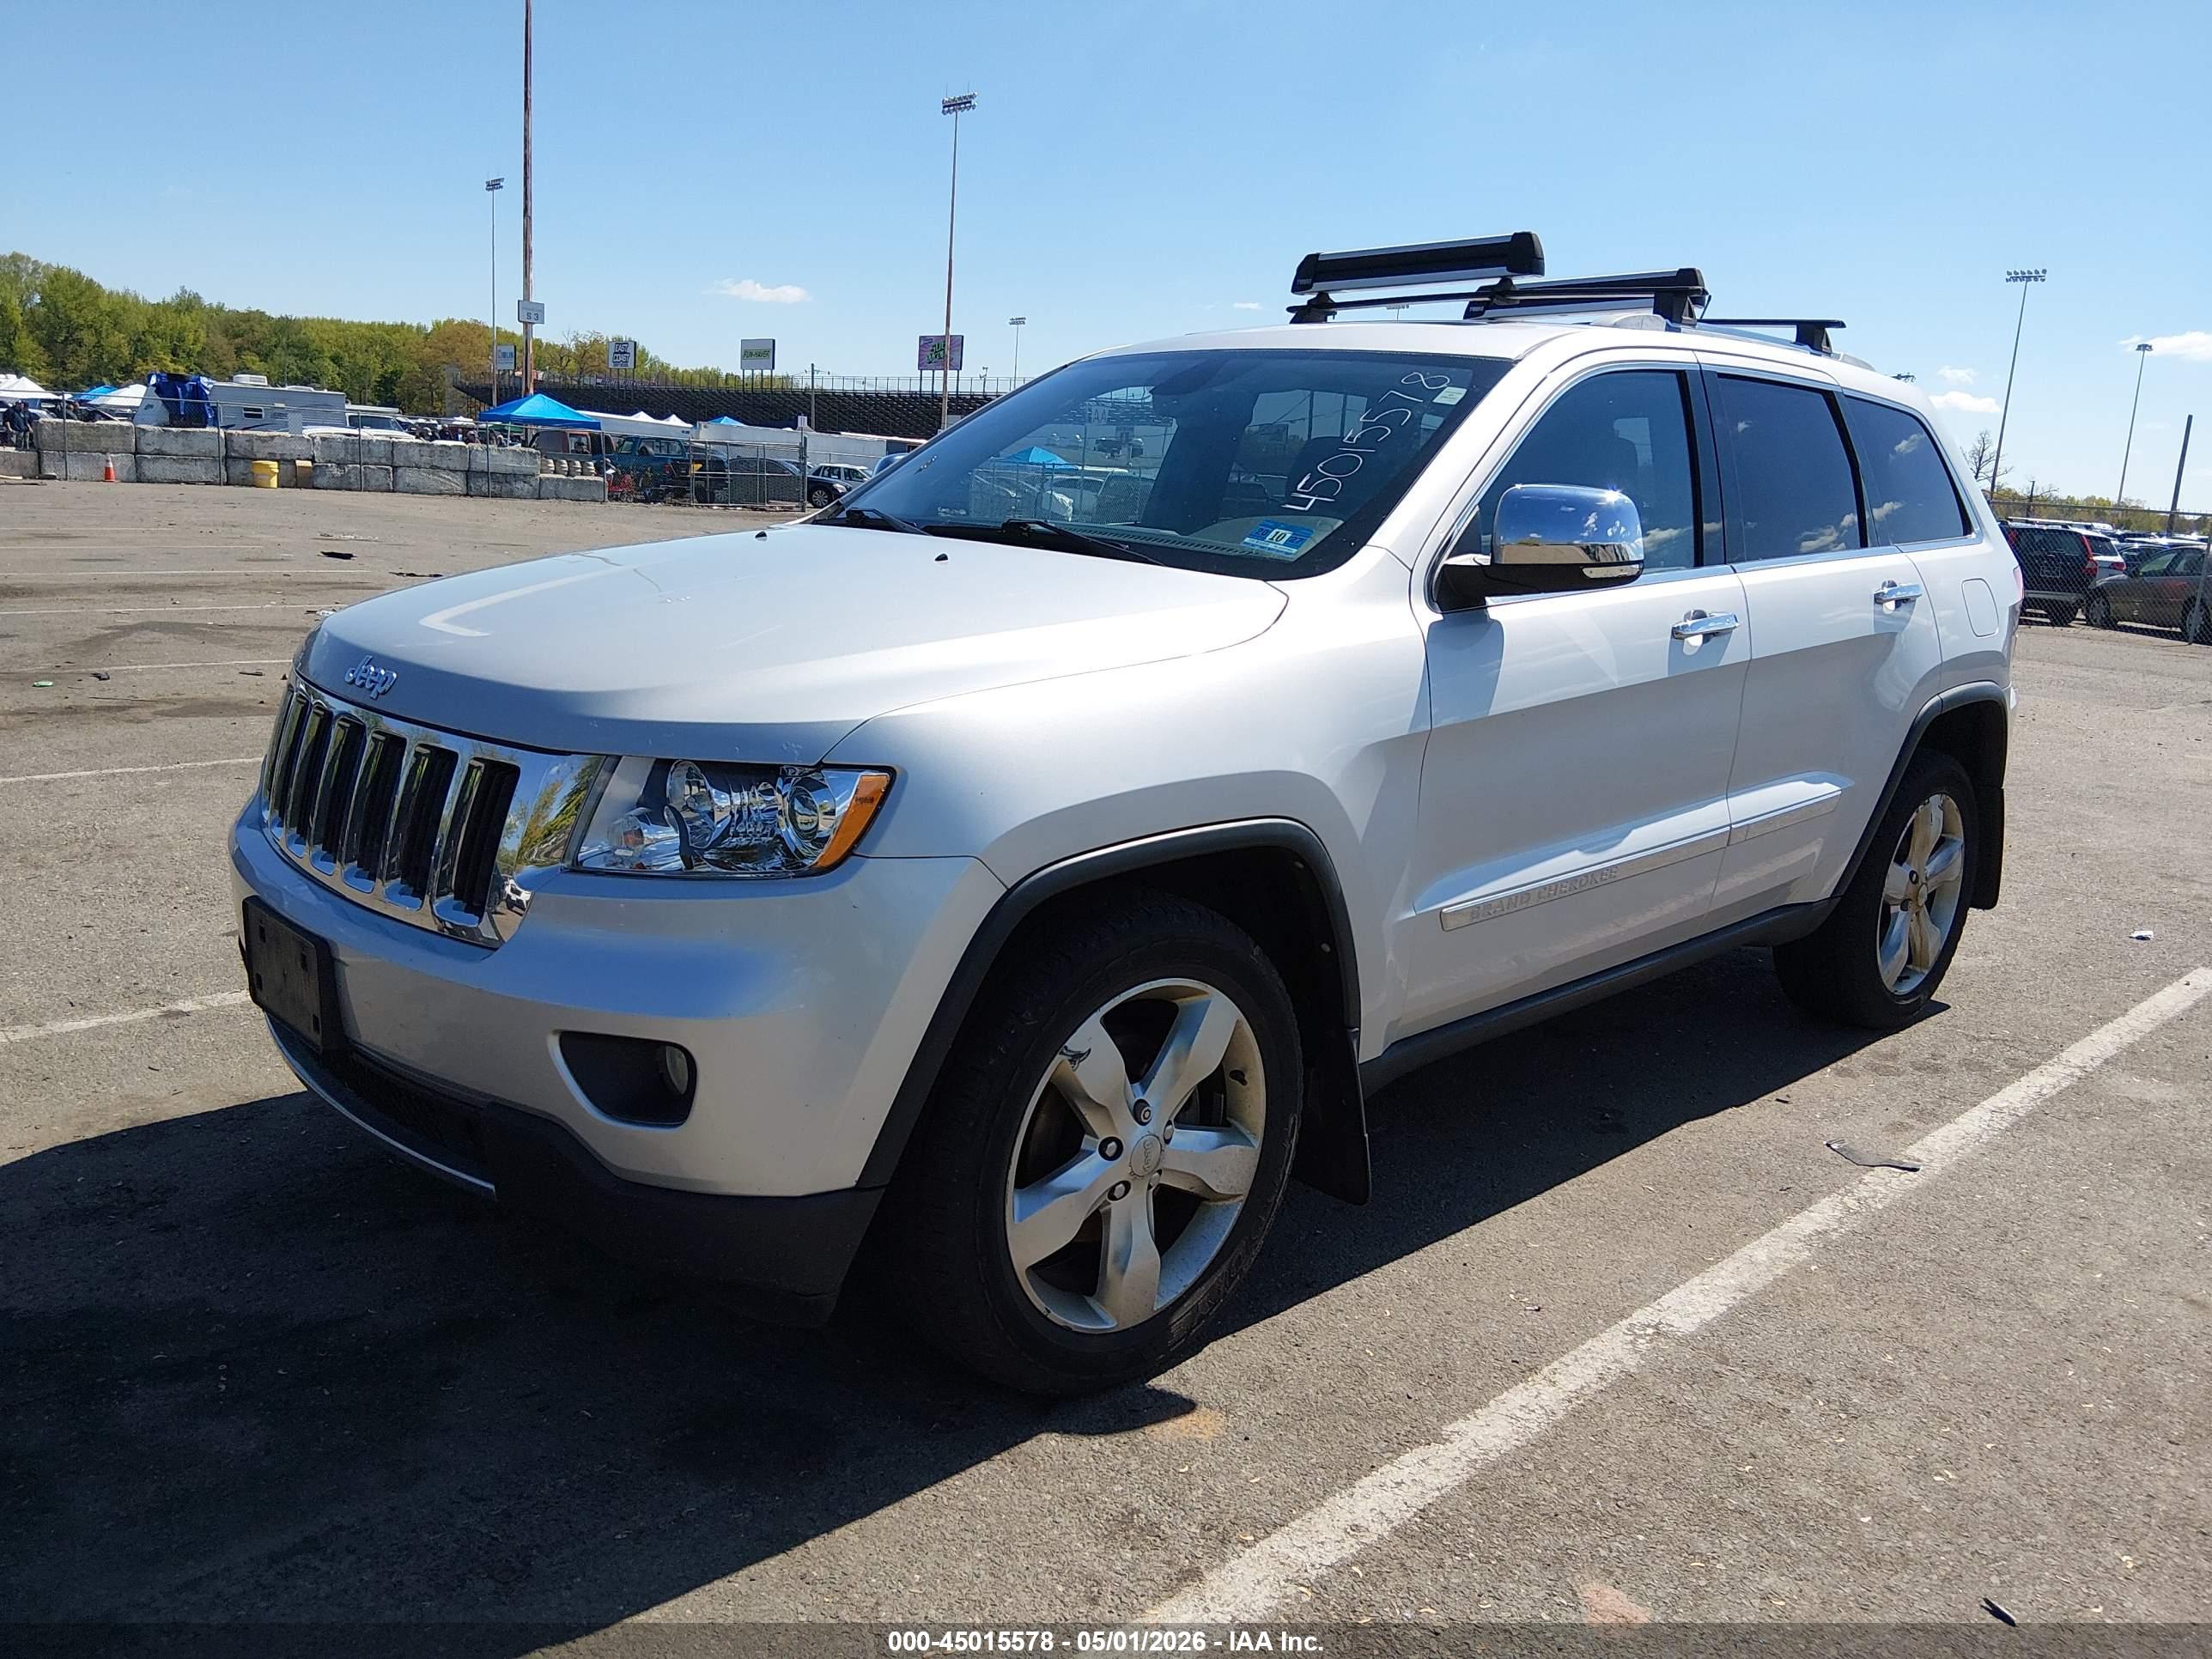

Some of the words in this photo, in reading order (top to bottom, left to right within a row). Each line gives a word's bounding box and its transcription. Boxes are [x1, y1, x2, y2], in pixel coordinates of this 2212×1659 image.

[534, 313, 539, 321] 3
[615, 343, 629, 353] EAST
[613, 353, 630, 362] COAST
[1279, 371, 1451, 512] 45015578
[1269, 531, 1287, 542] 10
[344, 654, 398, 701] Jeep
[1536, 866, 1620, 900] CHEROKEE
